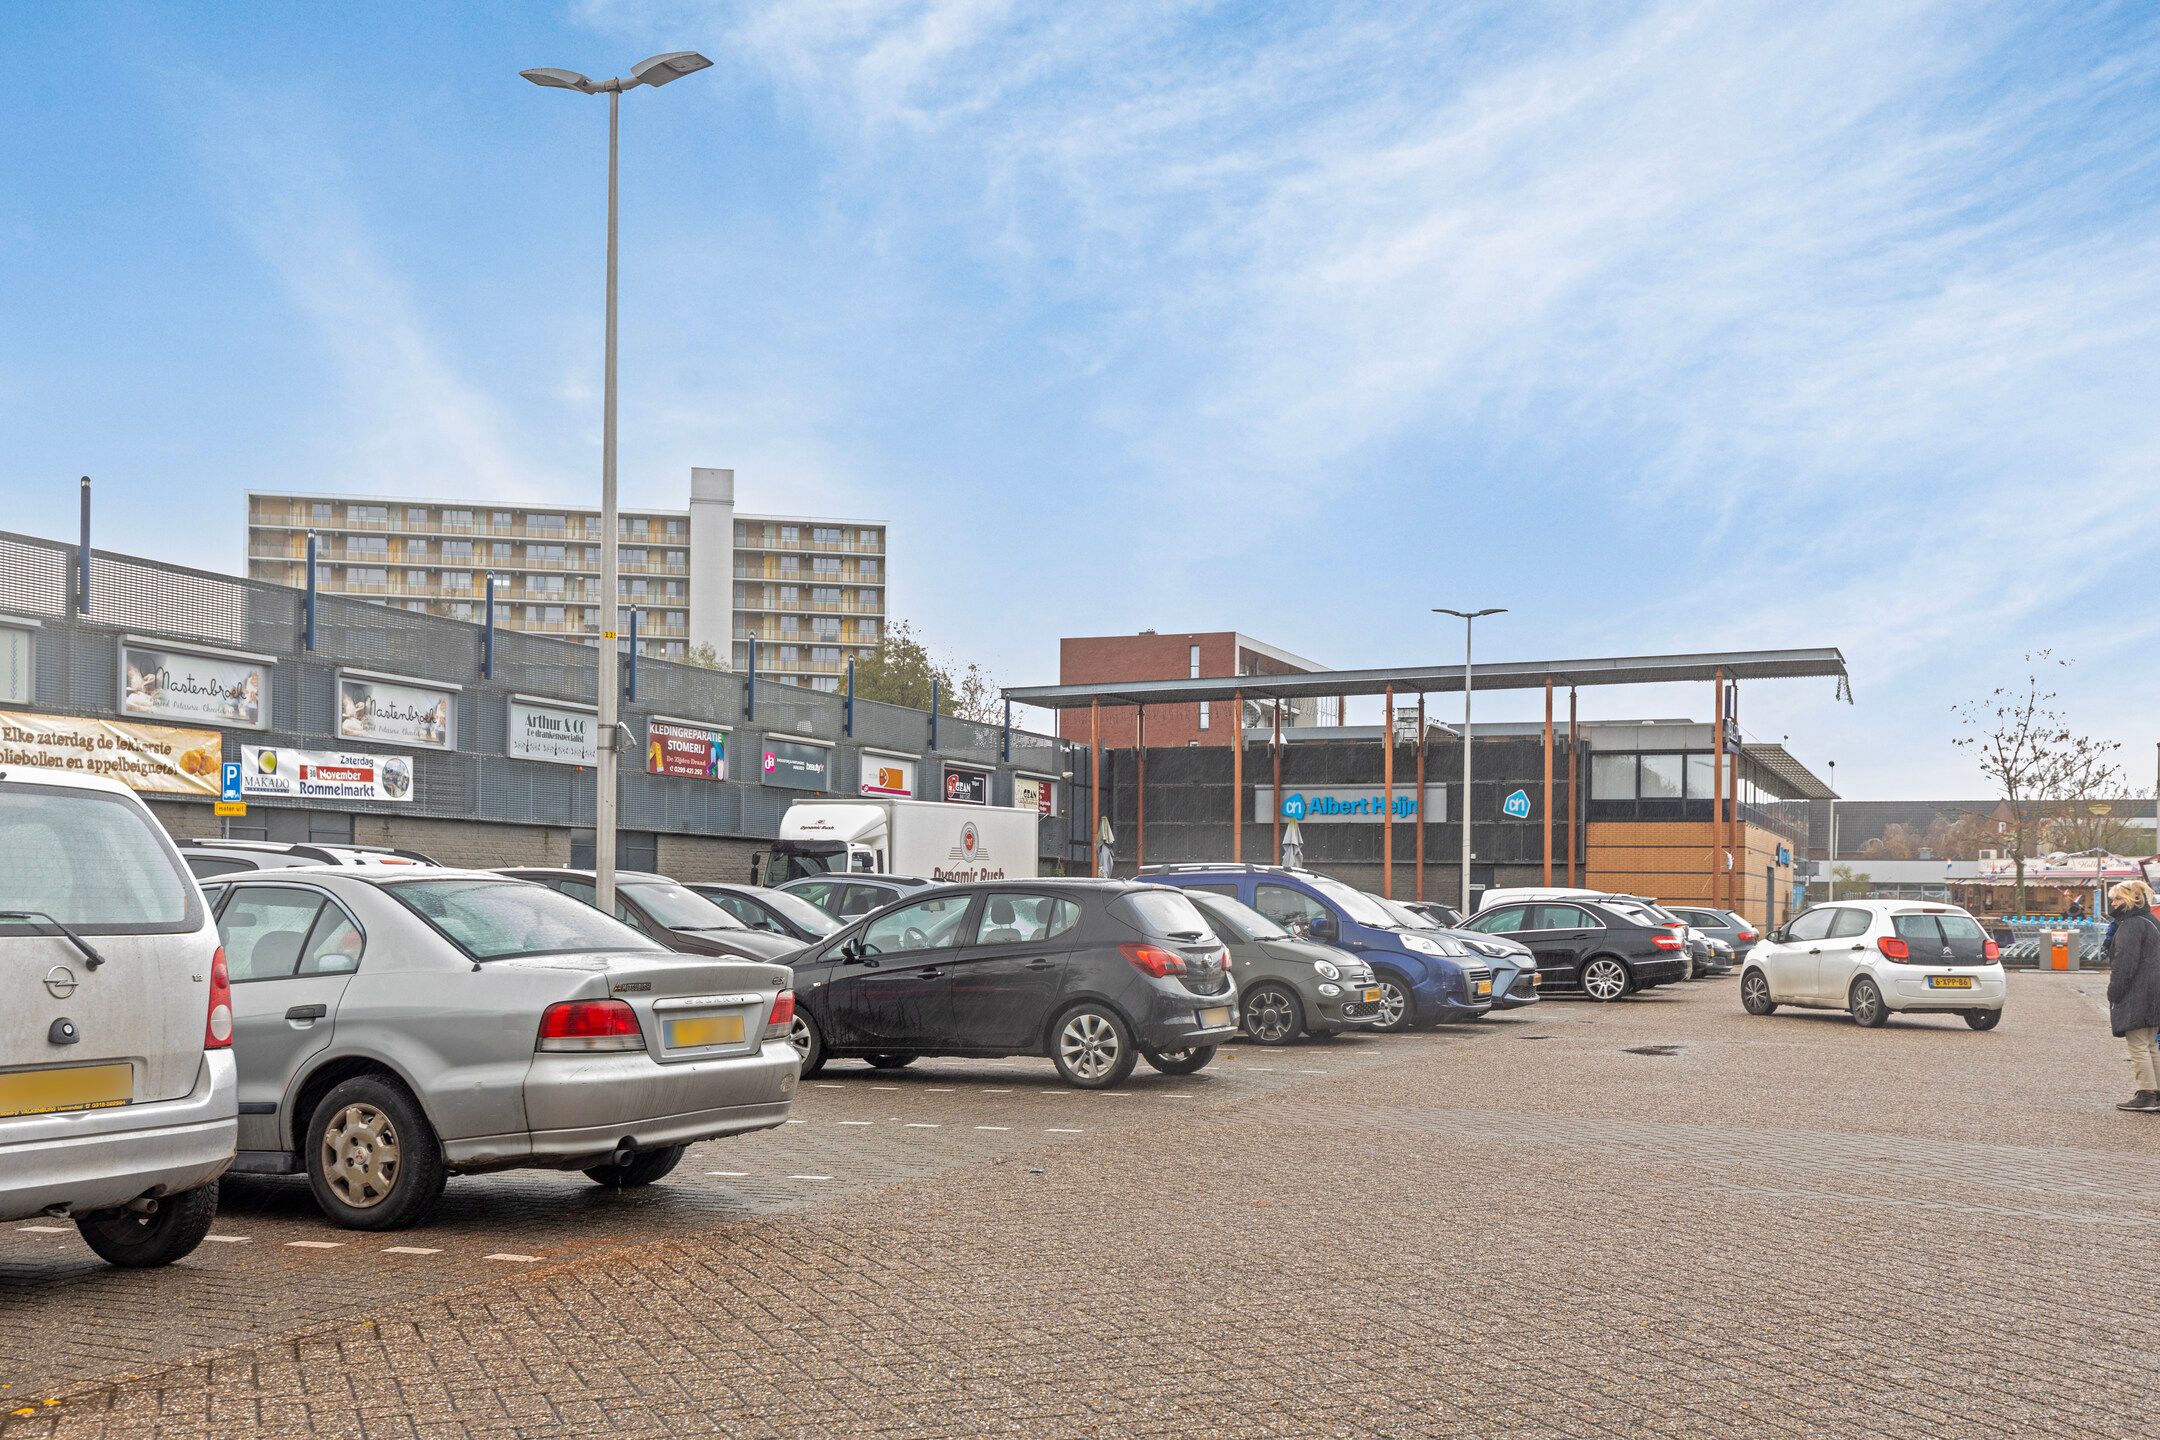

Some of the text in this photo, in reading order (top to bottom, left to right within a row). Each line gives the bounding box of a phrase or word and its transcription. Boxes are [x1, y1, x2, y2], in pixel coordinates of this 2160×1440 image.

[142, 660, 247, 701] Mastenbroek
[354, 690, 437, 725] Mastenbroek
[525, 713, 562, 731] Arthur
[564, 718, 571, 733] &
[2, 727, 172, 756] Elke zaterdag de lekkerste
[649, 723, 723, 743] KLEDINGREPARATIE
[667, 740, 705, 755] STOMERIJ
[66, 757, 83, 769] en
[340, 755, 374, 767] Zaterdag
[226, 765, 238, 786] P
[244, 776, 290, 789] MAKADO
[320, 769, 361, 781] November
[300, 781, 375, 798] Rommelmarkt
[1308, 796, 1368, 815] Albert
[933, 866, 978, 884] Dynamic
